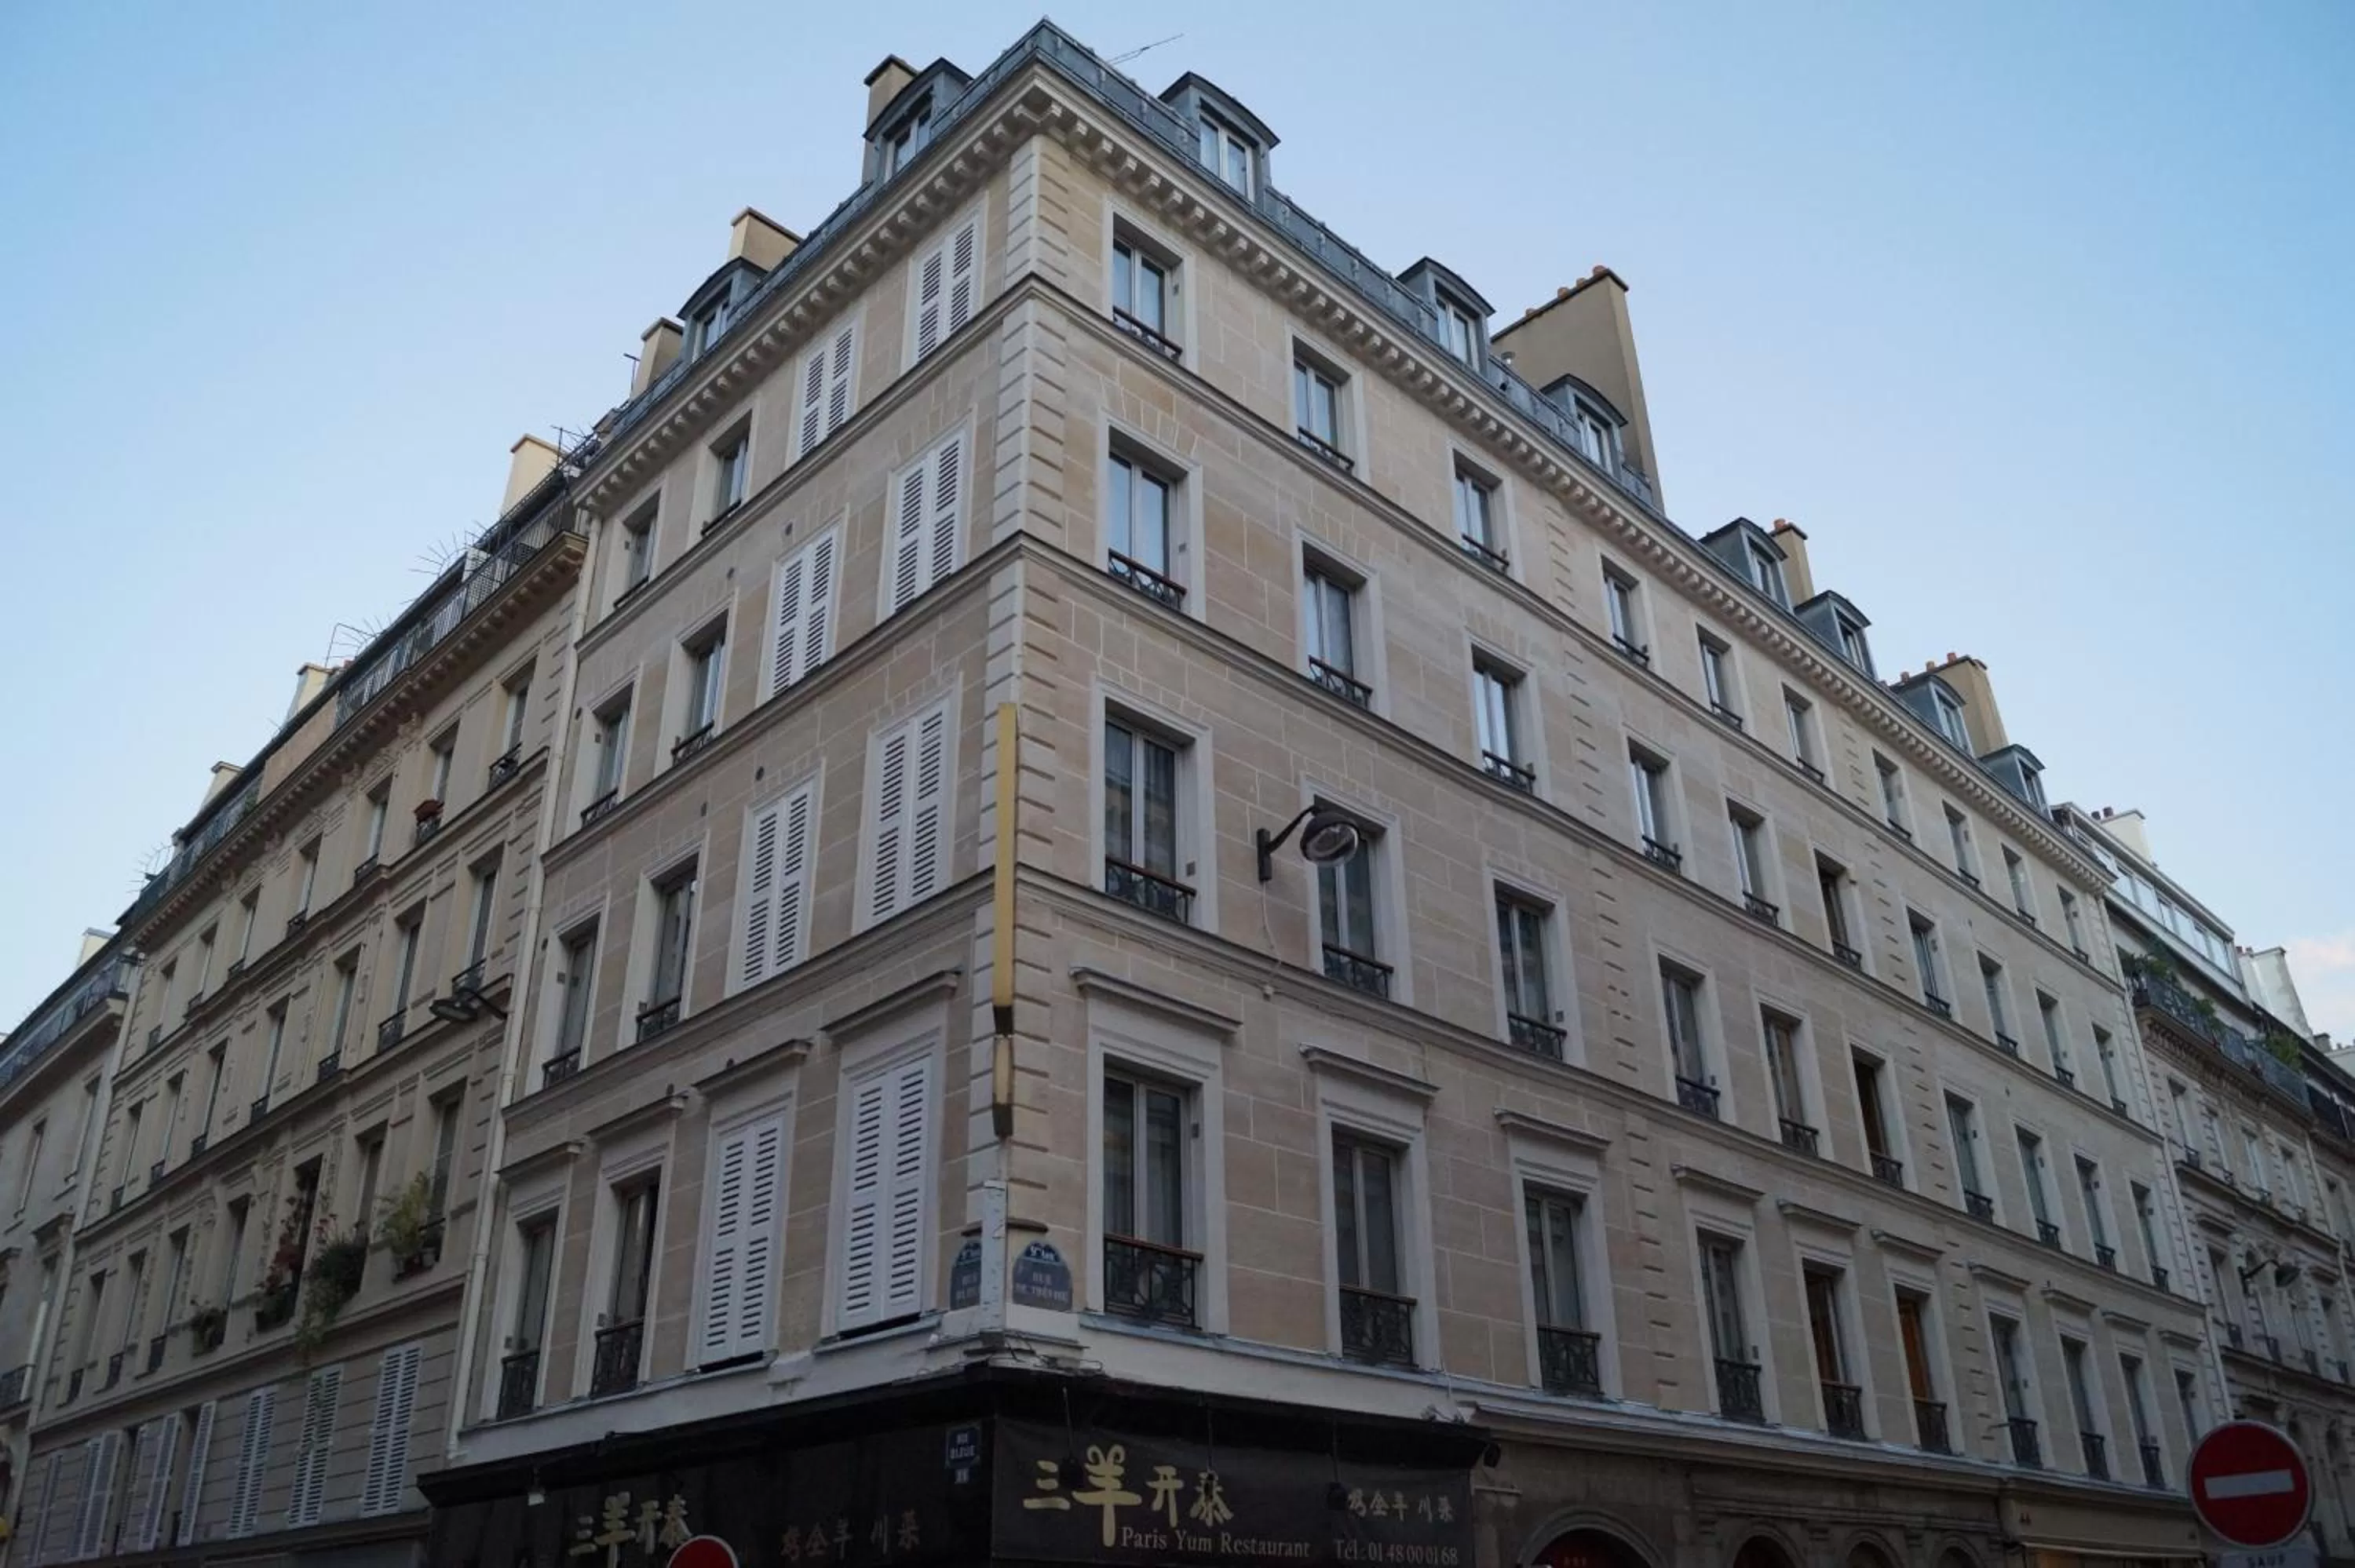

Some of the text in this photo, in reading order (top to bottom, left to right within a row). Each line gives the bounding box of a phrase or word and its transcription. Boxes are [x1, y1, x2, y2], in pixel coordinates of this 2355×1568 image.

[1119, 1526, 1311, 1557] Paris Yum Restaurant
